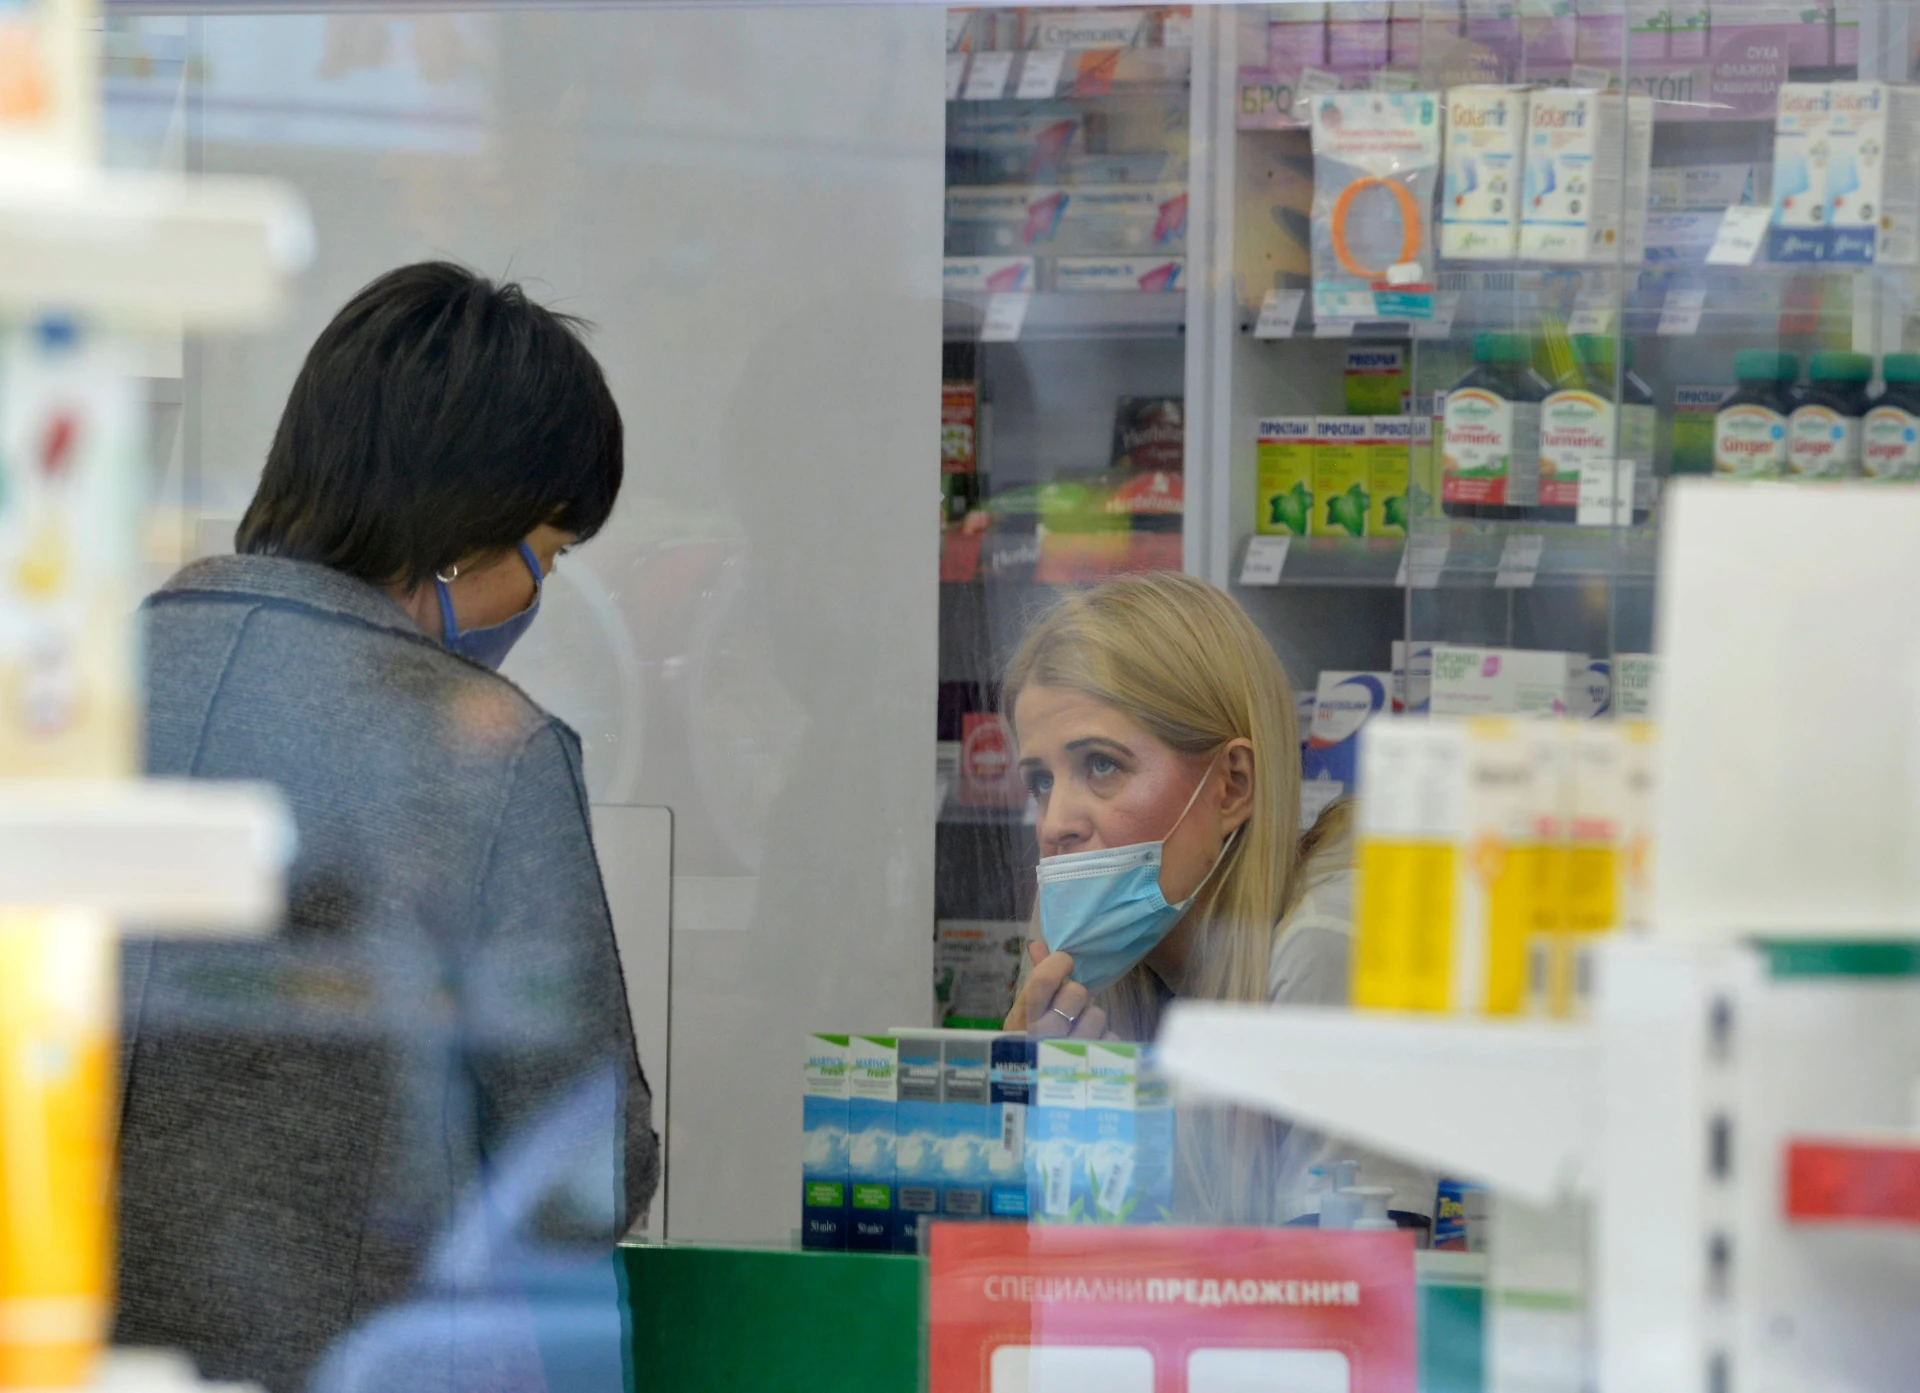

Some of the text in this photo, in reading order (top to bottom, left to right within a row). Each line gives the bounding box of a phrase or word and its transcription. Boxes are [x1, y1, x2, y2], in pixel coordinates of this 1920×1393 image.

[1260, 421, 1309, 436] ПРОСПАН
[1317, 422, 1366, 436] ПРОСПАН
[1374, 422, 1427, 436] ПРОСПАН
[1444, 429, 1503, 446] Turmeric
[1542, 431, 1605, 448] Turmeric
[1721, 436, 1774, 457] Ginger
[1794, 437, 1834, 457] Ginger
[1867, 440, 1907, 459] Ginger
[983, 1275, 1361, 1308] СПЕЦИАЛНИ ПРЕДЛОЖЕНИЯ
